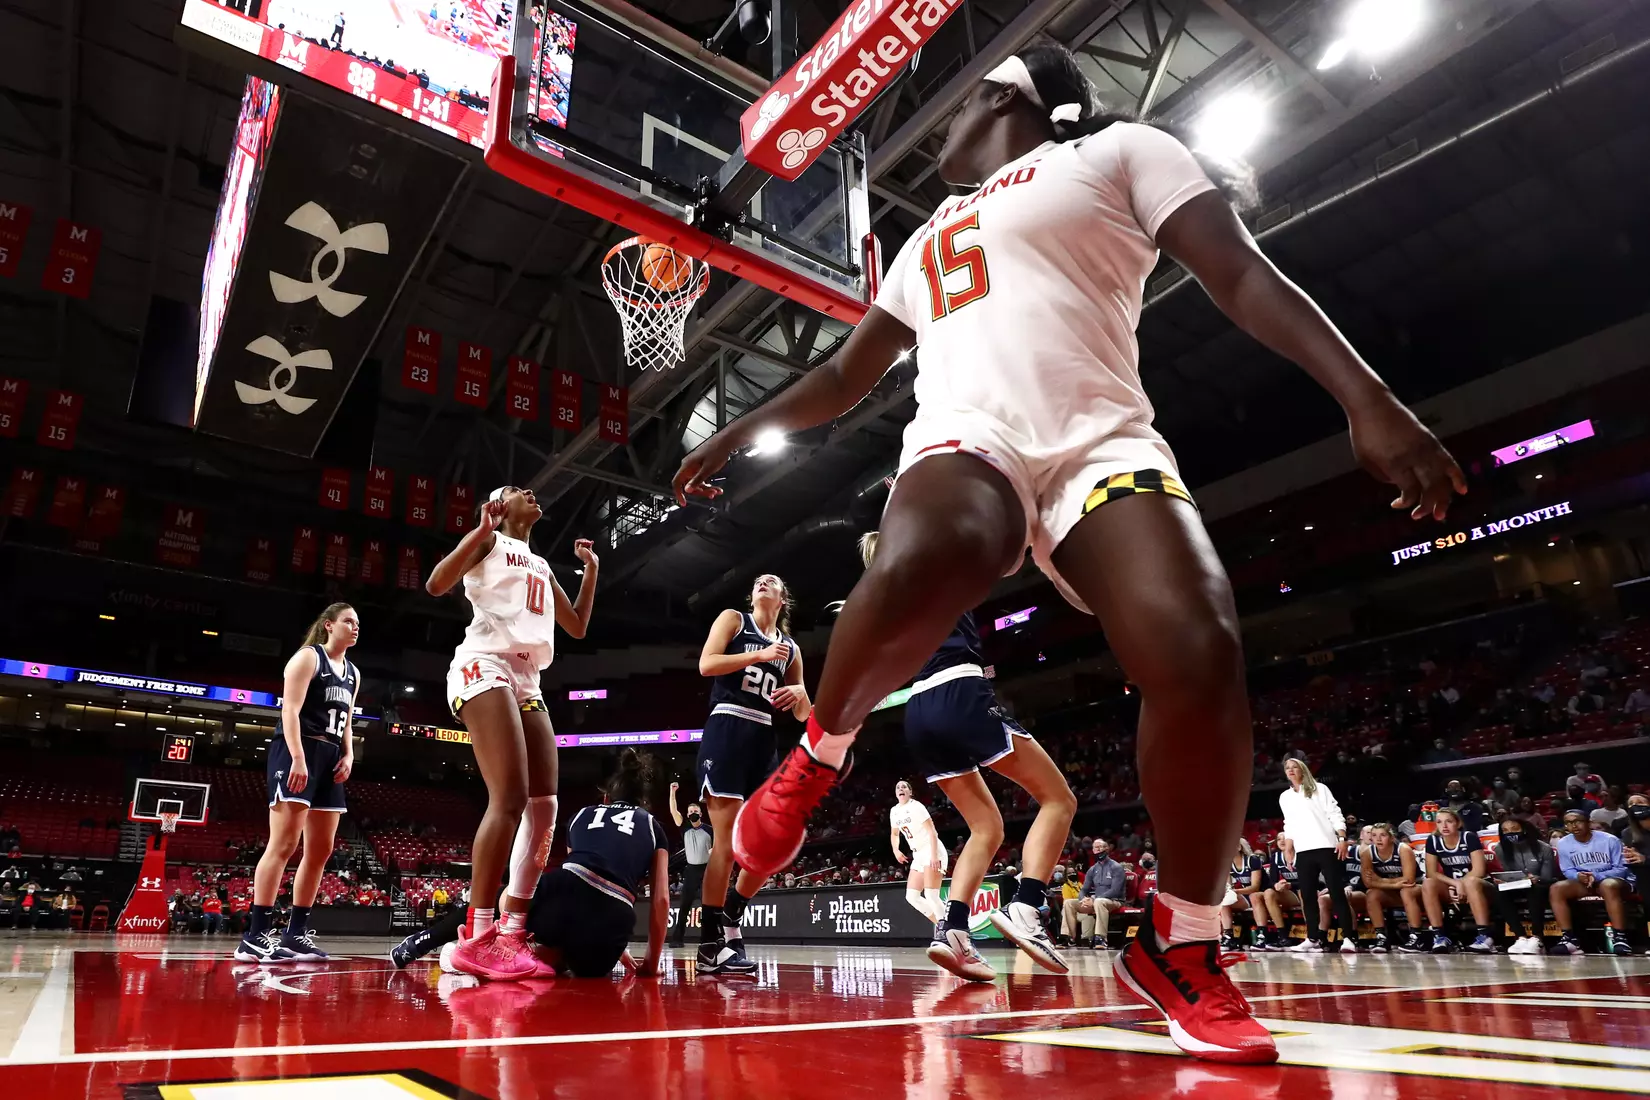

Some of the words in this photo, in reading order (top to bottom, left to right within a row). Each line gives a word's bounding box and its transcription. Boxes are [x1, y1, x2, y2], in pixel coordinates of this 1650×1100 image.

[811, 0, 960, 127] StateFa
[347, 61, 376, 92] 38
[412, 87, 450, 122] 1:41
[0, 203, 18, 221] M
[69, 225, 88, 243] M
[920, 210, 990, 322] 15
[62, 267, 75, 284] 3
[417, 330, 430, 345] M
[469, 346, 482, 361] M
[411, 365, 429, 383] 23
[518, 361, 530, 375] M
[3, 380, 18, 393] M
[562, 374, 573, 387] M
[464, 380, 480, 397] 15
[609, 387, 620, 400] M
[58, 393, 72, 407] M
[514, 394, 530, 411] 22
[558, 407, 574, 423] 32
[48, 425, 68, 441] 15
[607, 420, 621, 435] 42
[21, 470, 34, 481] M
[375, 469, 386, 481] M
[66, 478, 79, 491] M
[417, 478, 427, 490] M
[105, 488, 119, 500] M
[327, 488, 341, 503] 41
[456, 487, 466, 498] M
[370, 498, 385, 511] 54
[175, 509, 194, 528] M
[412, 507, 426, 519] 25
[456, 516, 463, 527] 6
[302, 529, 311, 539] M
[334, 535, 343, 545] M
[1392, 541, 1432, 565] JUST
[1435, 532, 1467, 549] $10
[1471, 527, 1486, 541] A
[1487, 501, 1573, 536] MONTH
[370, 541, 380, 551] M
[406, 548, 415, 558] M
[107, 588, 160, 610] xfinity
[526, 572, 546, 616] 10
[461, 661, 483, 686] M
[78, 672, 146, 688] JUDGEMENT
[146, 681, 174, 692] FREE
[175, 684, 206, 696] ZONE
[741, 665, 777, 702] 20
[325, 708, 348, 738] 12
[436, 729, 458, 741] LEDO
[462, 731, 472, 743] PI
[168, 746, 187, 760] 20
[587, 808, 635, 836] 14
[1571, 851, 1611, 867] VILLANOVA
[829, 895, 879, 919] planet
[124, 915, 166, 930] xfinity
[742, 904, 777, 927] NTH
[812, 911, 822, 923] pf
[836, 916, 890, 933] fitness
